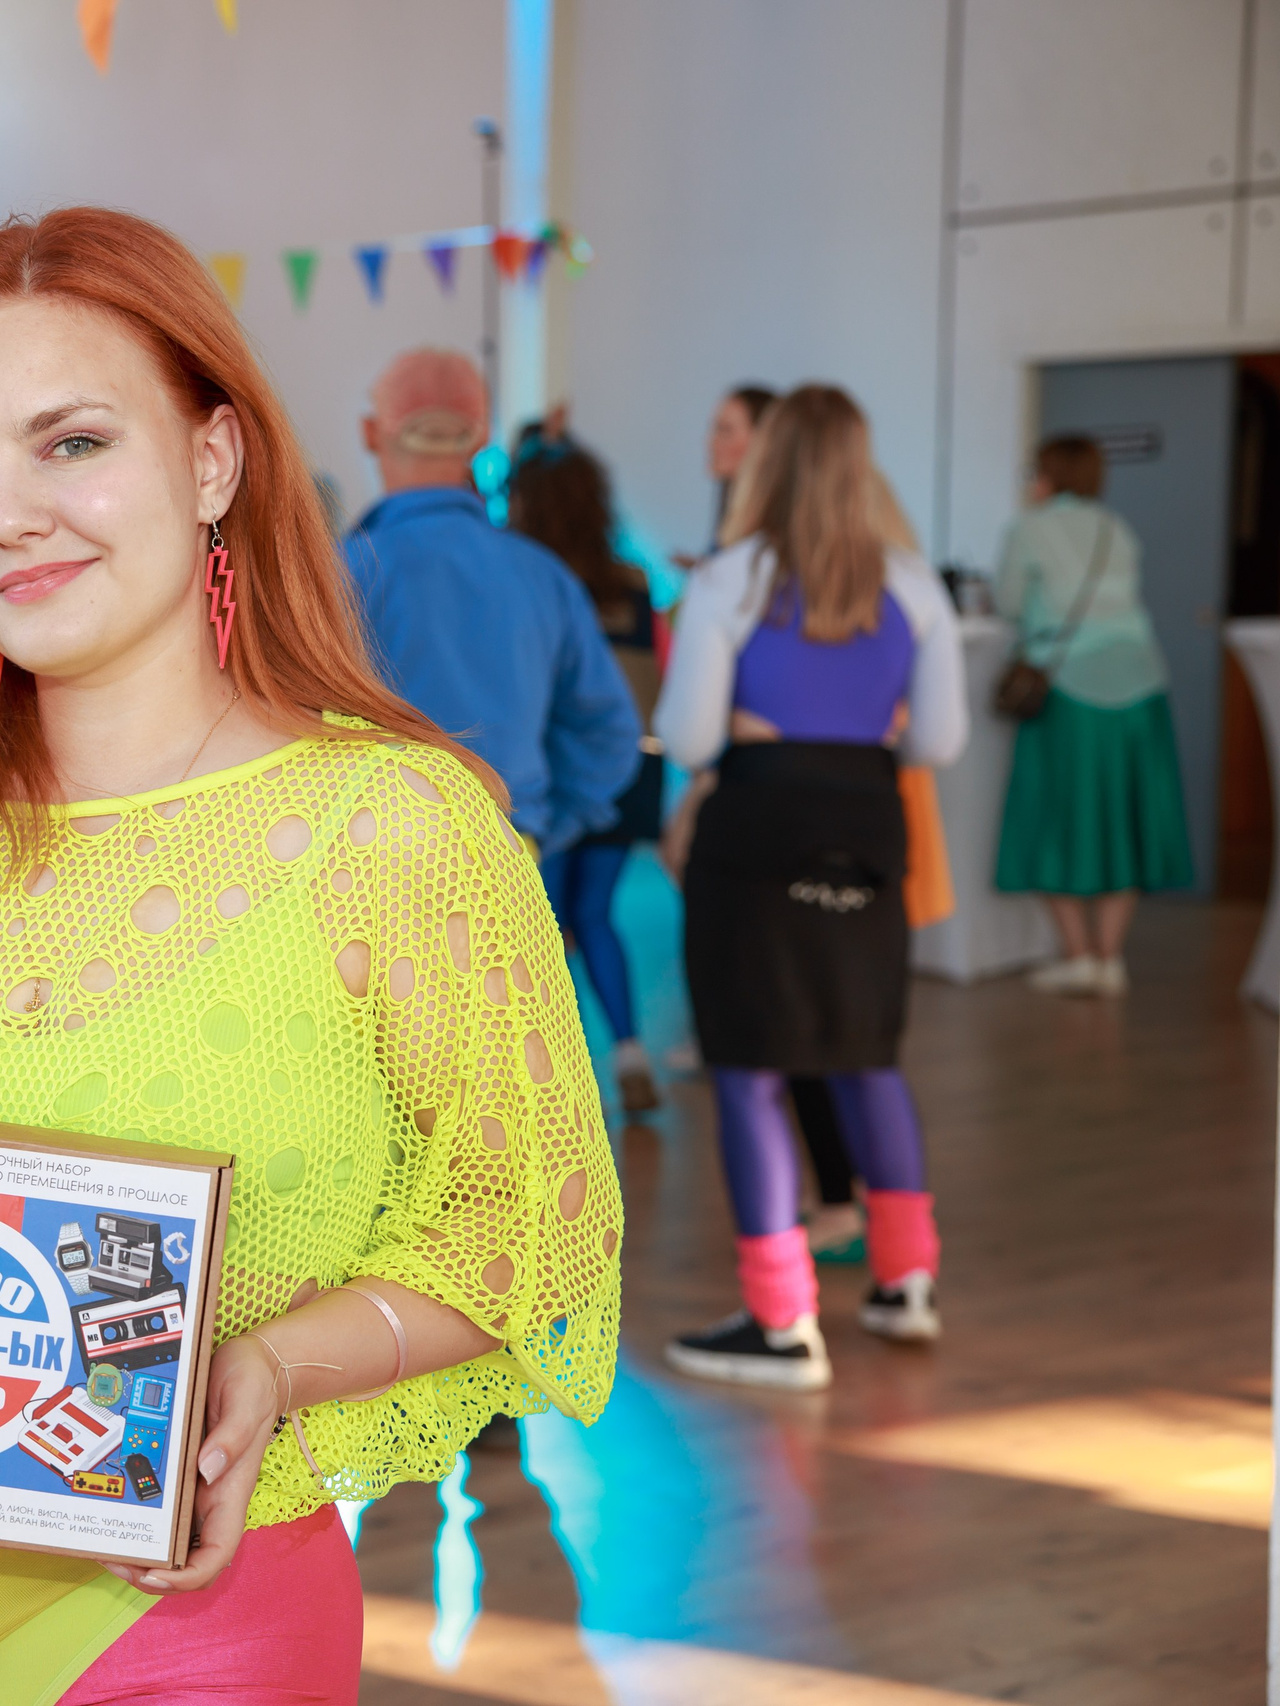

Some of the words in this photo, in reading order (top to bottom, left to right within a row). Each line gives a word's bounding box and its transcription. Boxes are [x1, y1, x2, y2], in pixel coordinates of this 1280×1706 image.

[46, 1161, 92, 1177] НАБОР
[7, 1171, 104, 1195] ПЕРЕМЕЩЕНИЯ
[107, 1185, 115, 1196] В
[118, 1186, 188, 1206] ПРОШЛОЕ
[9, 1515, 38, 1526] ВАГАН
[39, 1520, 65, 1531] ВИЛС
[69, 1524, 77, 1532] И
[78, 1526, 117, 1538] МНОГОЕ
